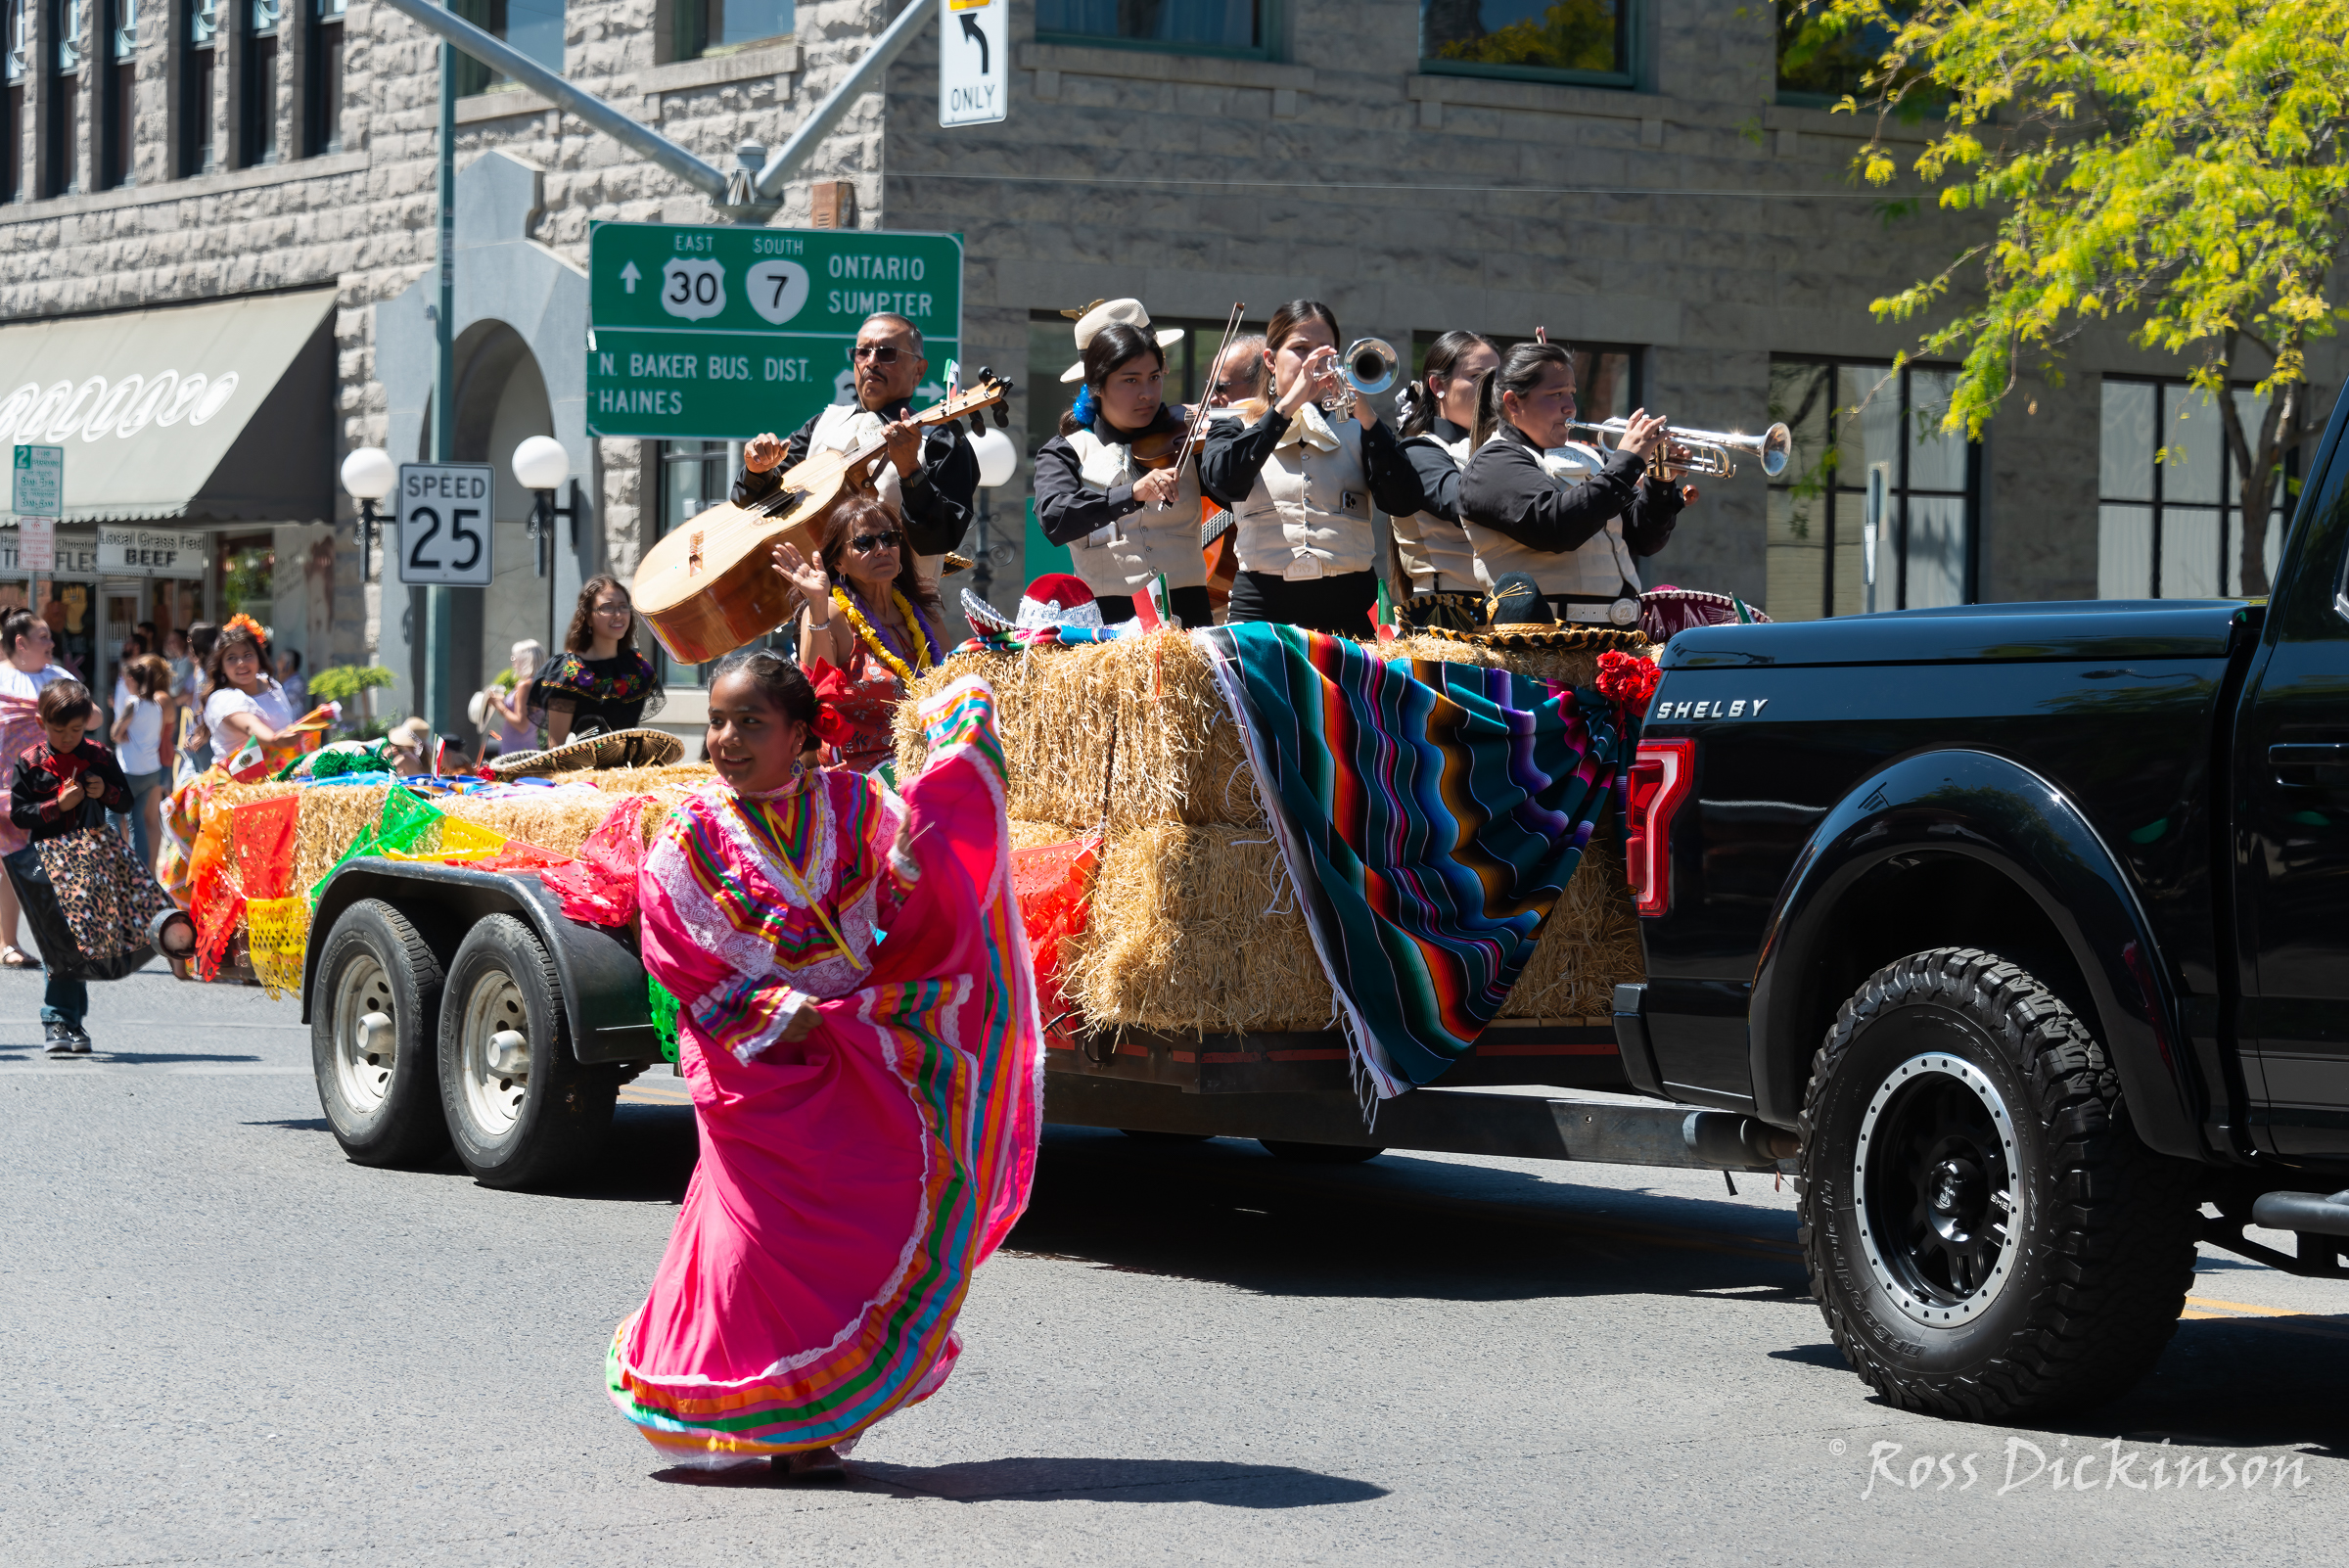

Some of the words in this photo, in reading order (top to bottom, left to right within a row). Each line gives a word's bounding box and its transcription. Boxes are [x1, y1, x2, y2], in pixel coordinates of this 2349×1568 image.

[949, 84, 996, 112] ONLY
[674, 235, 714, 252] EAST
[753, 237, 804, 255] SOUTH
[828, 254, 926, 281] ONTARIO
[669, 271, 718, 306] 30
[766, 275, 789, 309] 7
[827, 291, 933, 317] SUMPTER
[599, 352, 619, 377] N.
[629, 353, 698, 379] BAKER
[708, 355, 753, 381] BUS.
[764, 357, 813, 383] DIST.
[599, 389, 683, 415] HAINES
[17, 446, 28, 468] 2
[407, 475, 486, 499] SPEED
[99, 530, 136, 546] Local
[138, 530, 177, 549] Grass
[409, 506, 484, 572] 25
[125, 548, 178, 567] BEEF
[1656, 699, 1769, 719] SHELBY
